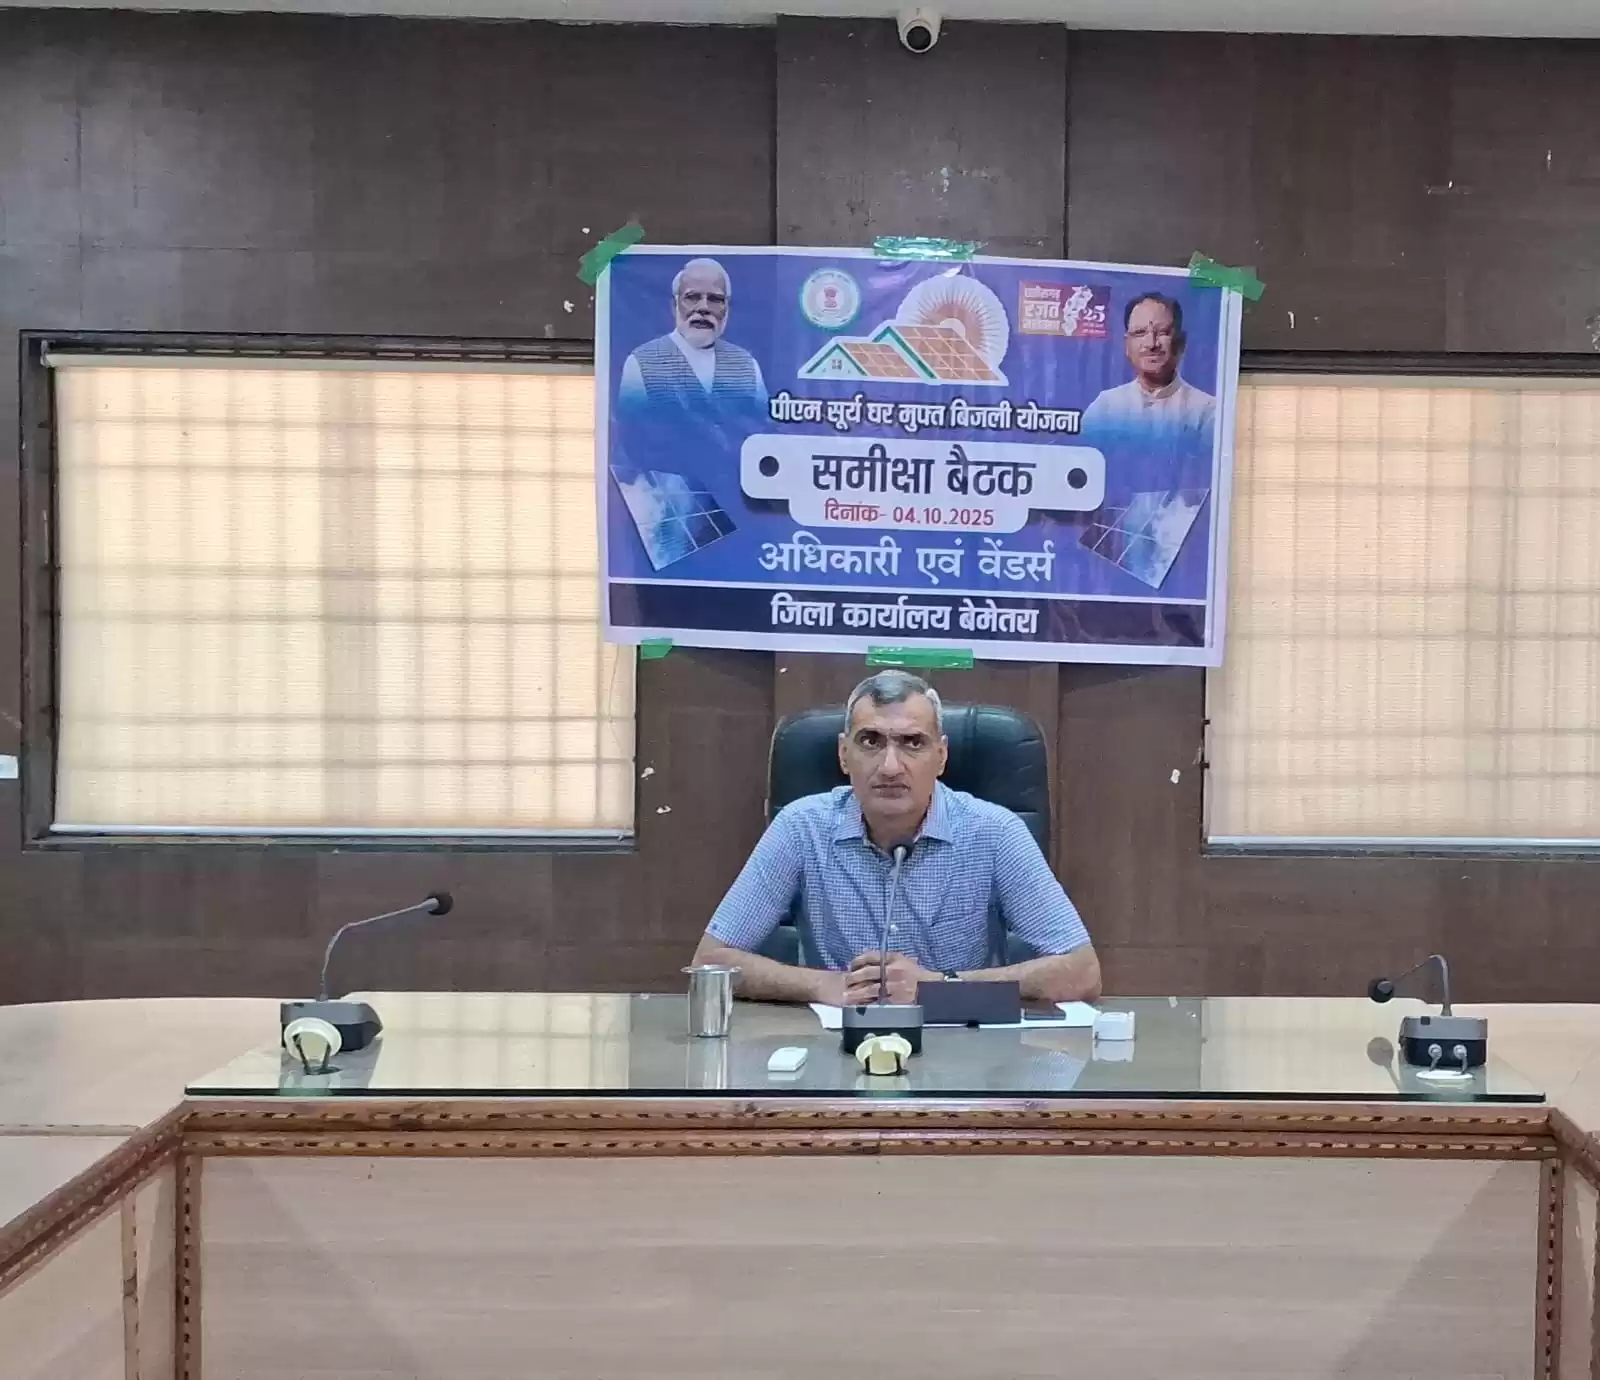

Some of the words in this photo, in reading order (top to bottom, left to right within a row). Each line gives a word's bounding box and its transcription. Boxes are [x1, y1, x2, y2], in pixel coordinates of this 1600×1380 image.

[1083, 304, 1106, 323] 25
[770, 391, 823, 422] पीएम
[827, 394, 863, 430] सूर्य
[866, 402, 894, 424] घर
[898, 404, 946, 433] मुफ्त
[949, 398, 1013, 429] बिजली
[1015, 401, 1081, 433] योजना
[811, 443, 936, 495] समीक्षा
[945, 443, 1038, 498] बैठक
[824, 497, 887, 523] दिनांक-
[892, 506, 995, 527] 04.10.2025
[757, 530, 903, 577] अधिकारी
[915, 536, 965, 586] एवं
[976, 535, 1057, 583] वेंडर्स
[769, 591, 837, 628] जिला
[841, 595, 953, 632] कार्यालय
[957, 598, 1040, 635] बेमेतरा
